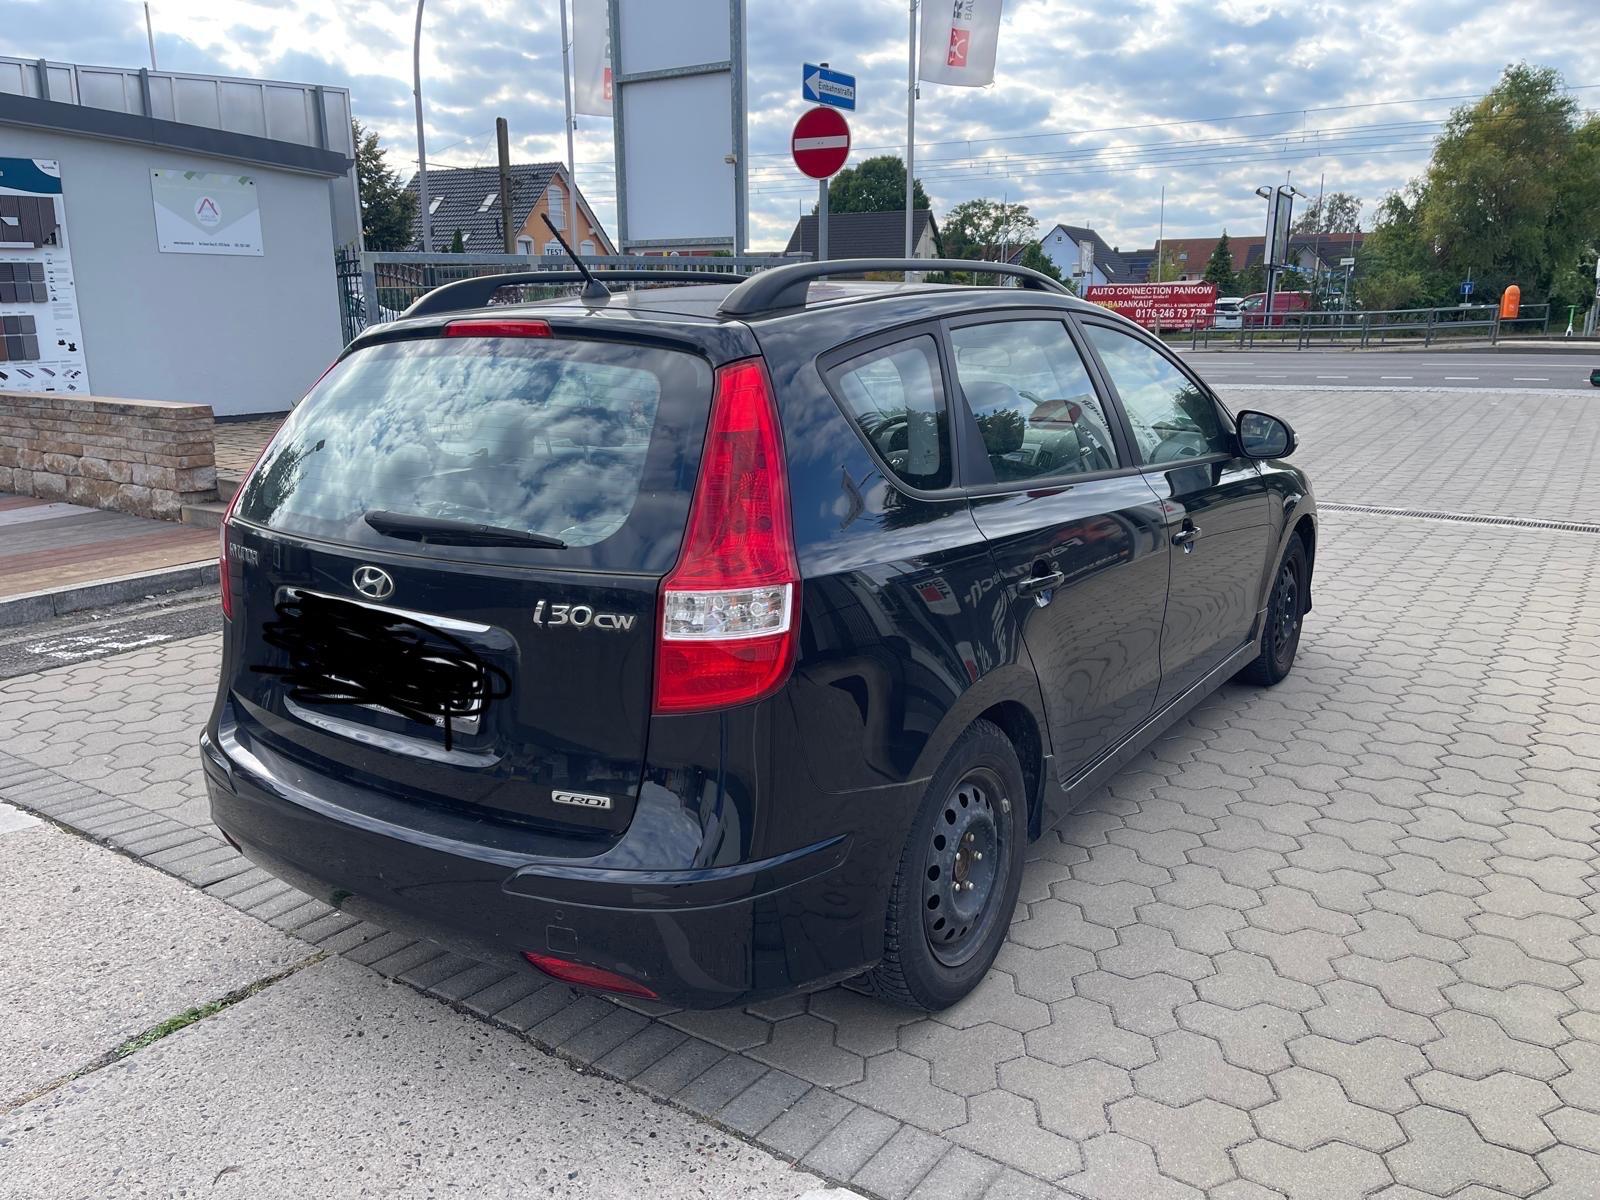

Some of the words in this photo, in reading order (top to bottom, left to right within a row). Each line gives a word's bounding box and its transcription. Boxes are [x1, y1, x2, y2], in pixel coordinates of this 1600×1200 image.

[818, 81, 853, 97] Einbahnstraße
[546, 248, 563, 256] TEST
[1091, 287, 1115, 296] AUTO
[1116, 286, 1172, 296] CONNECTION
[1173, 285, 1213, 295] PANKOW
[1159, 308, 1175, 318] 246
[1177, 308, 1188, 318] 79
[555, 795, 606, 806] CRDi
